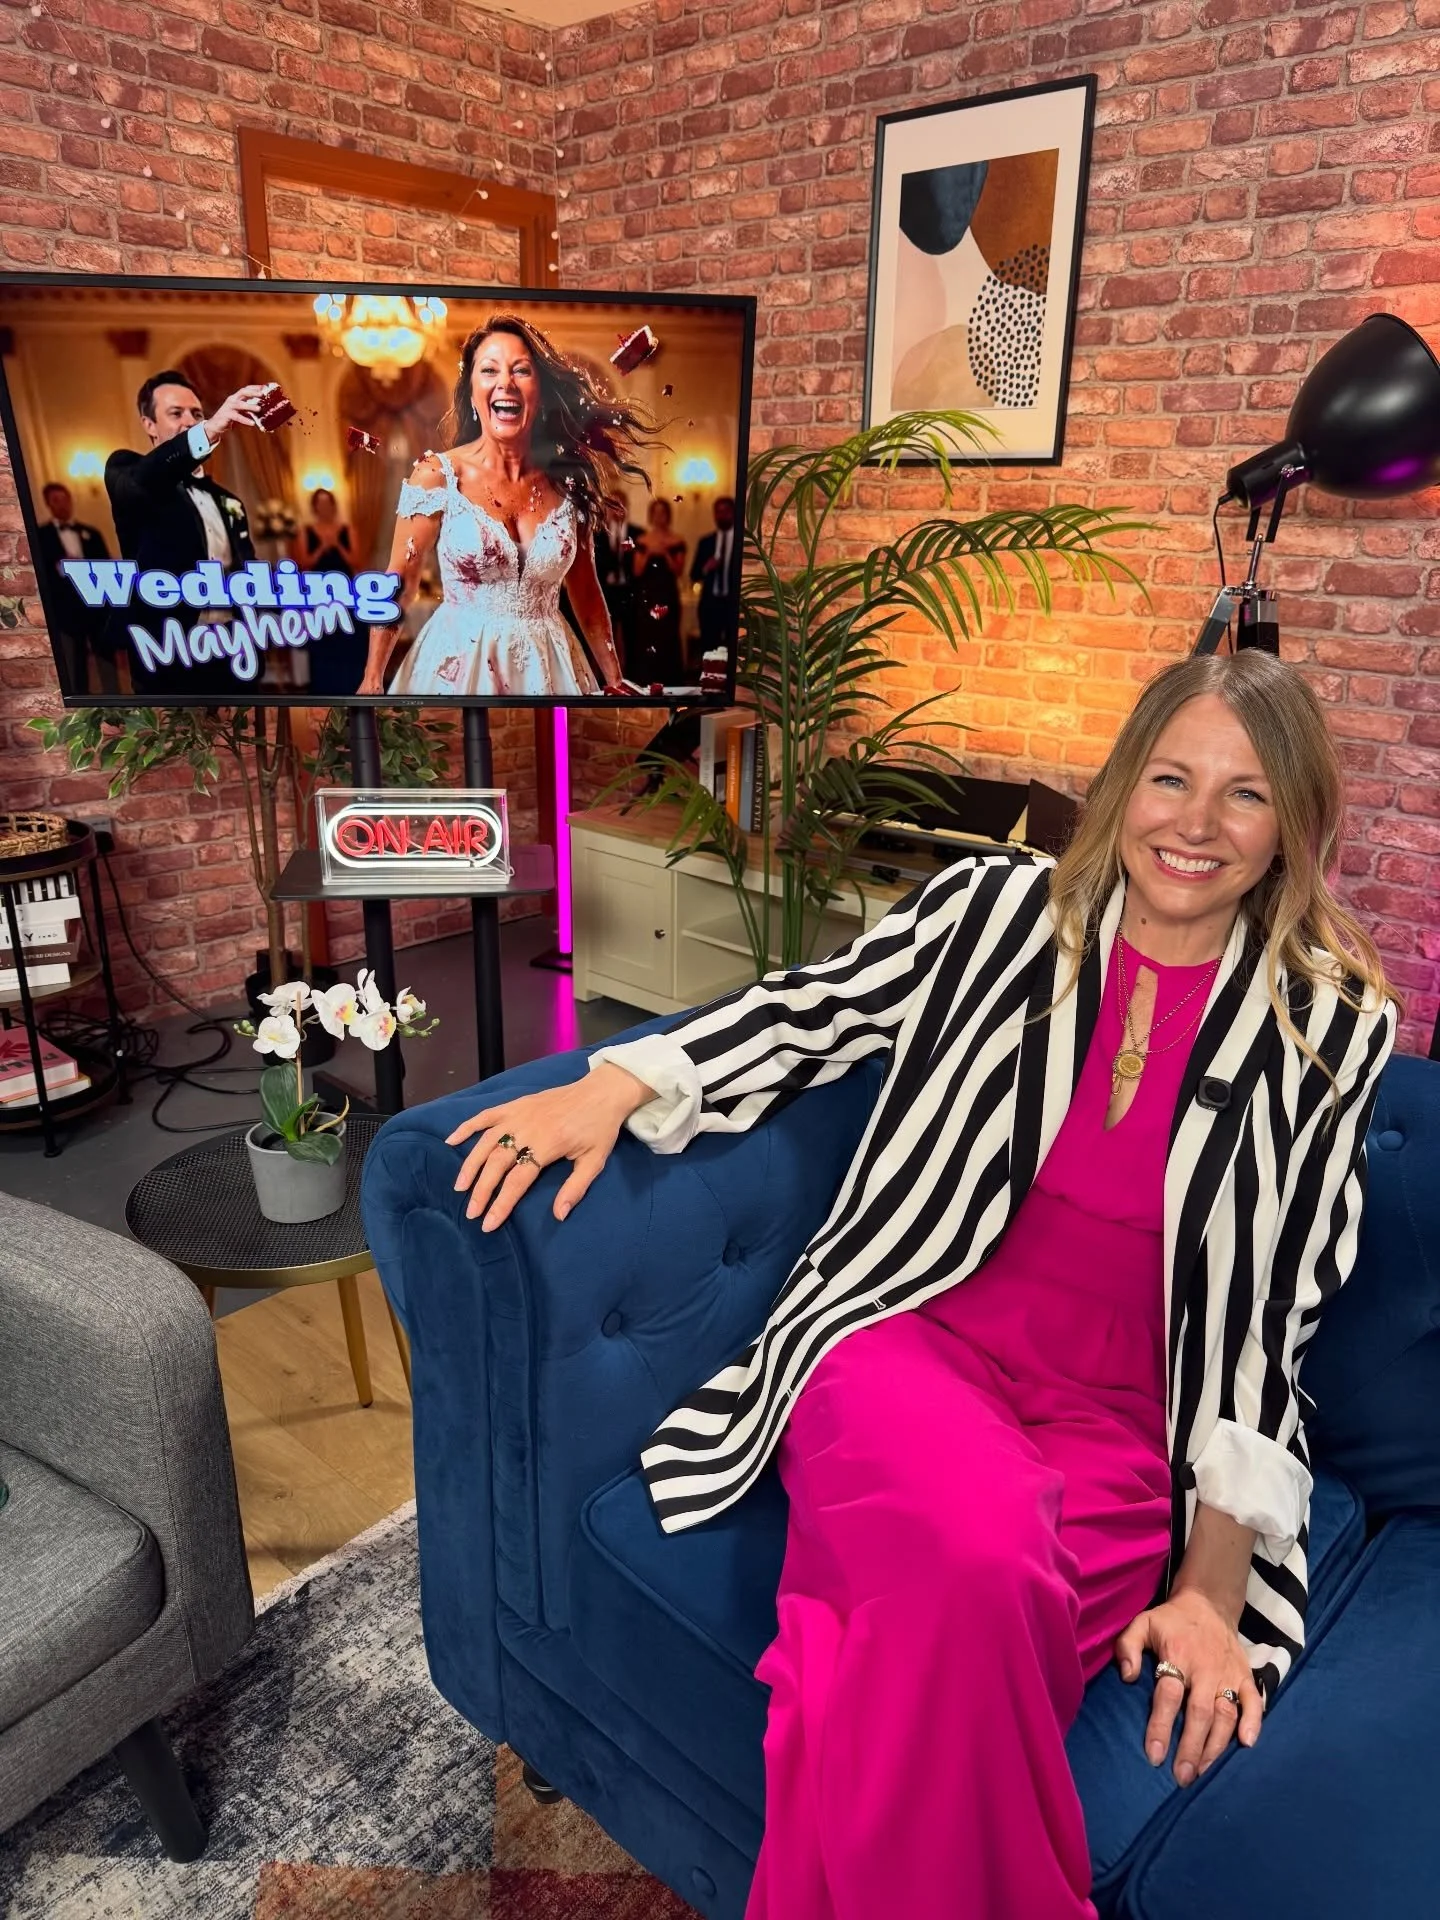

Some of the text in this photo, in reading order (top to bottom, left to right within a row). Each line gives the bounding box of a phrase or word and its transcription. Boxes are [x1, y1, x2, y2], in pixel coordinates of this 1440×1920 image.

[61, 559, 401, 622] Wedding
[128, 600, 355, 680] Mayhem
[755, 782, 763, 794] IN
[753, 797, 762, 831] STYLE
[337, 818, 489, 857] ON AIR
